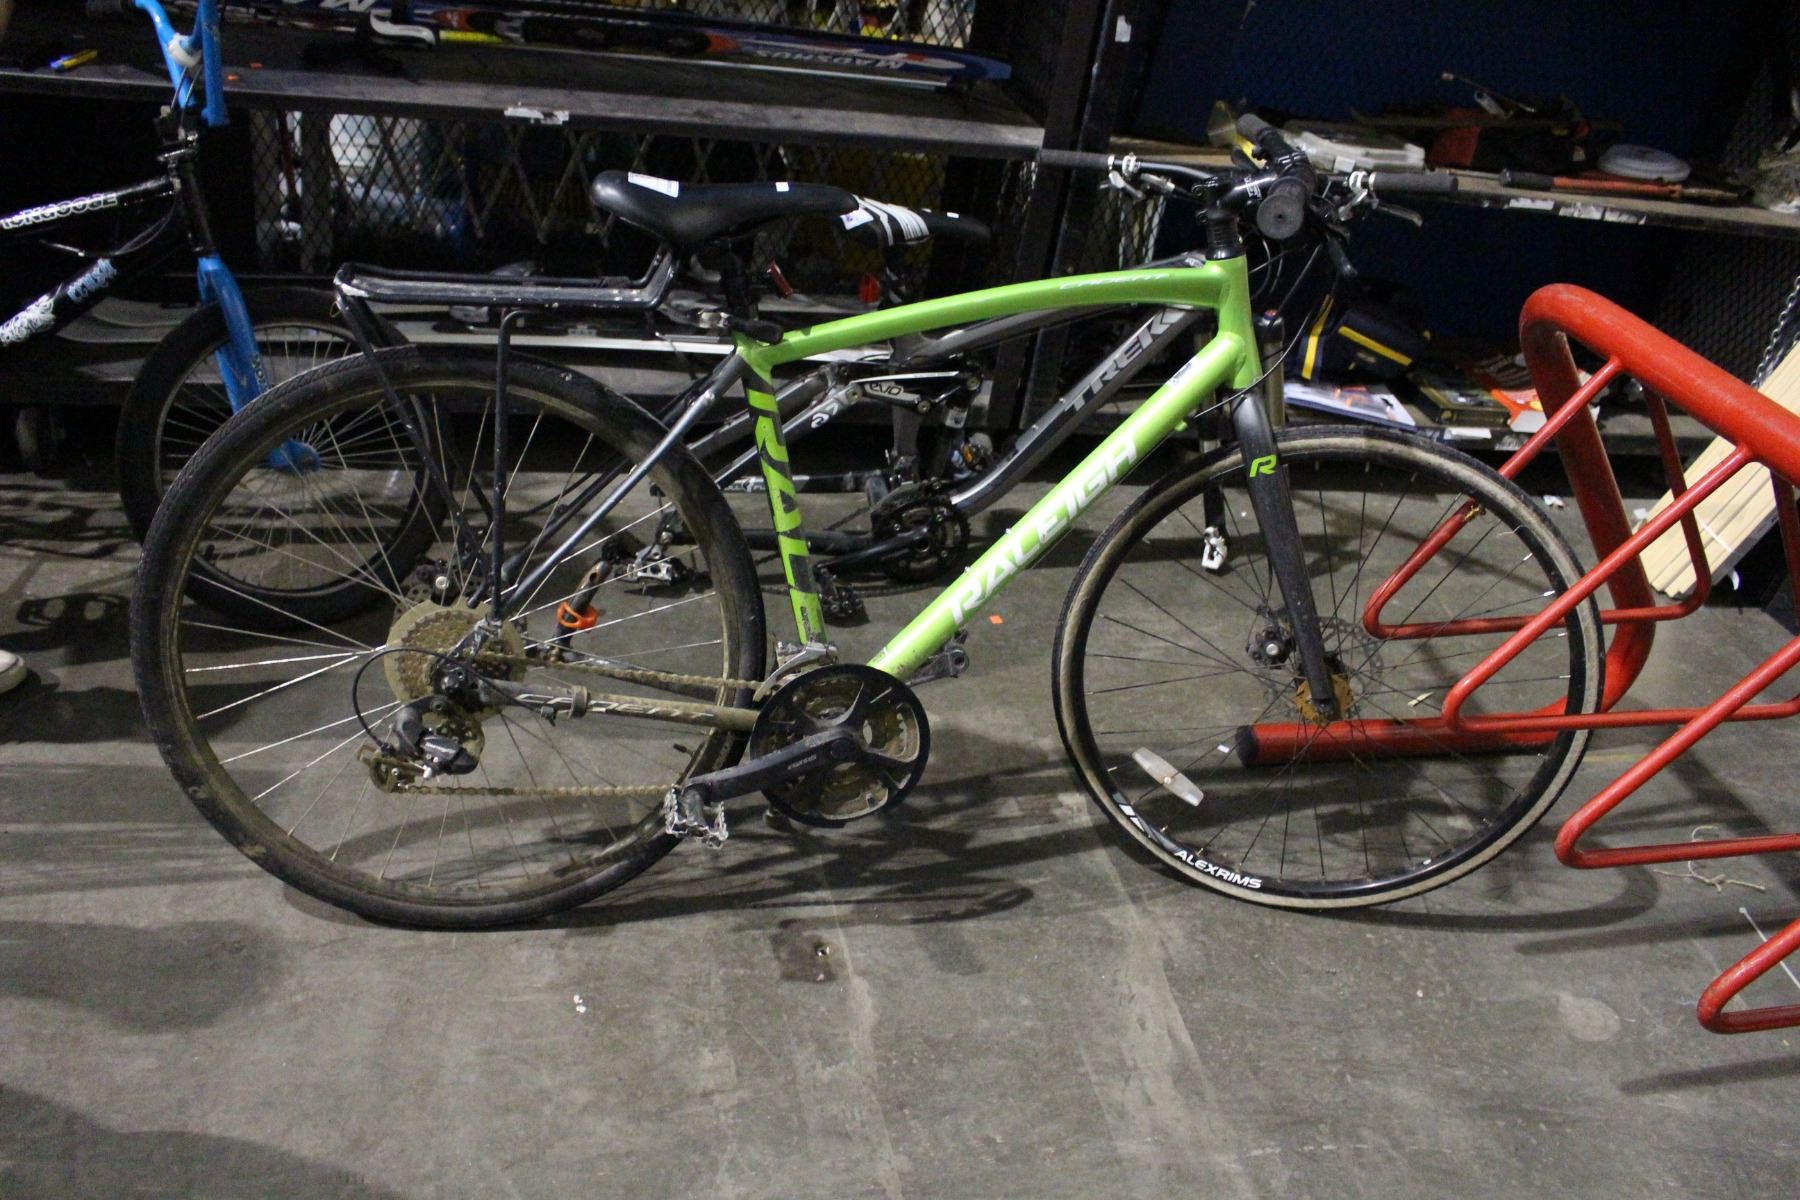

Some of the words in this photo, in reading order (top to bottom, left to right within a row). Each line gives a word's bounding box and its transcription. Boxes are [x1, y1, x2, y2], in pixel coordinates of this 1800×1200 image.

[1063, 307, 1187, 412] TREK
[1249, 454, 1277, 478] R
[950, 433, 1137, 626] RALEIGH
[1173, 849, 1263, 890] ALEXRIMS
